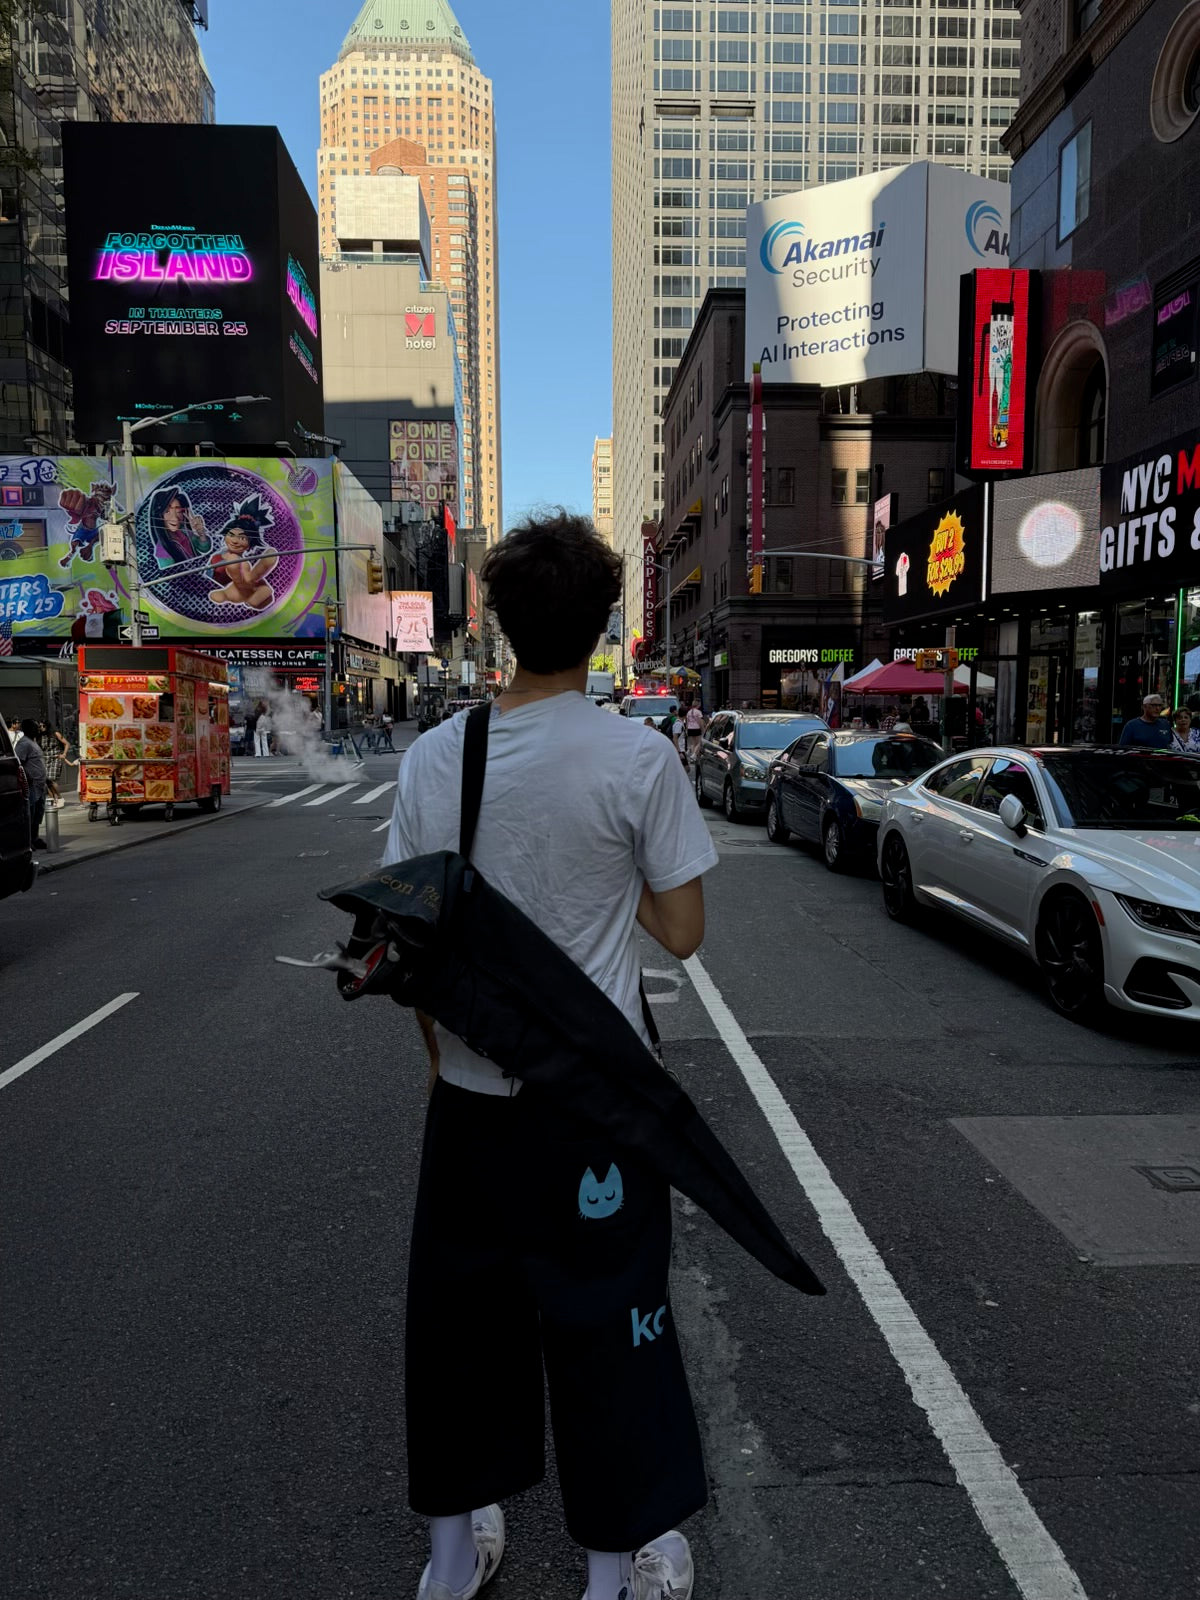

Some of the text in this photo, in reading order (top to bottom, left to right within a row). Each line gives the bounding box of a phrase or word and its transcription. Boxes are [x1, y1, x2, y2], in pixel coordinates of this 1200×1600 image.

[104, 233, 245, 250] FORGOTTEN
[782, 221, 886, 267] Akamai
[96, 248, 253, 281] ISLAND
[792, 257, 881, 288] Security
[128, 307, 223, 319] IN THEATERS
[405, 305, 435, 314] citizen
[777, 301, 885, 334] Protecting
[104, 320, 248, 336] SEPTEMBER 25
[406, 338, 436, 349] hotel
[782, 327, 905, 360] Interactions
[391, 422, 452, 438] COME
[408, 443, 452, 459] ONE
[410, 484, 455, 500] COM
[1120, 454, 1172, 515] NYC
[1100, 506, 1177, 573] GIFTS
[34, 597, 55, 614] 25
[769, 649, 854, 663] GREGORYS COFFEE
